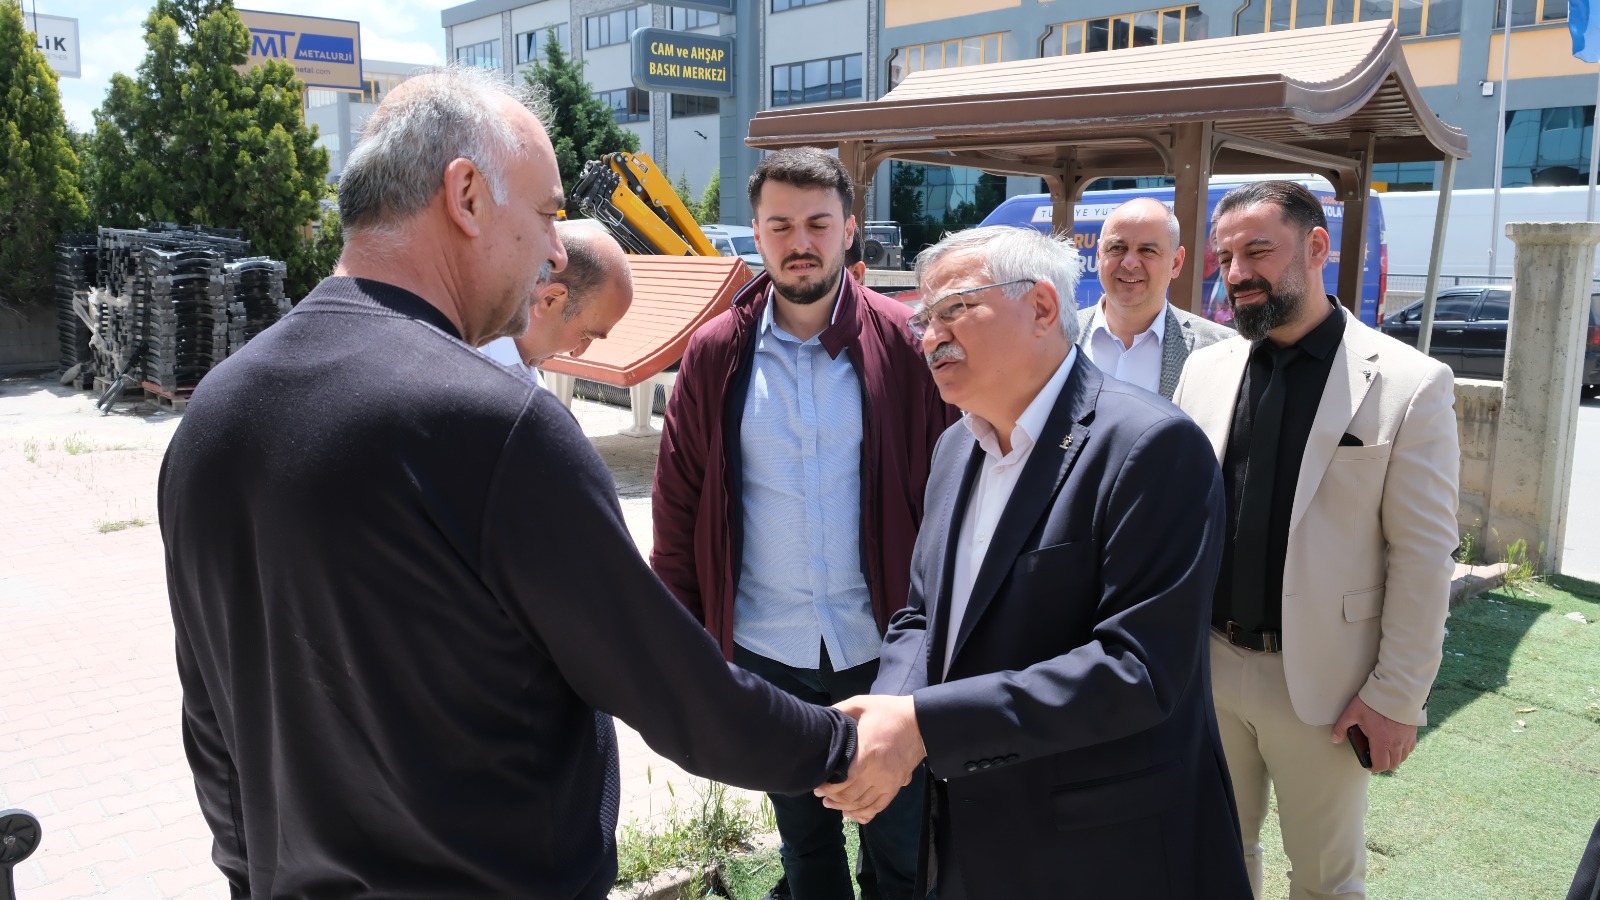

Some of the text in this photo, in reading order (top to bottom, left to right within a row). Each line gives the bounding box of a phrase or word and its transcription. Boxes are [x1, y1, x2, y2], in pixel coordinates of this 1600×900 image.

[35, 35, 67, 51] LİK
[249, 28, 295, 58] MT
[651, 41, 724, 64] CAM ve AHŞAP
[299, 49, 352, 62] METALURJİ
[649, 61, 726, 82] BASKI MERKEZİ
